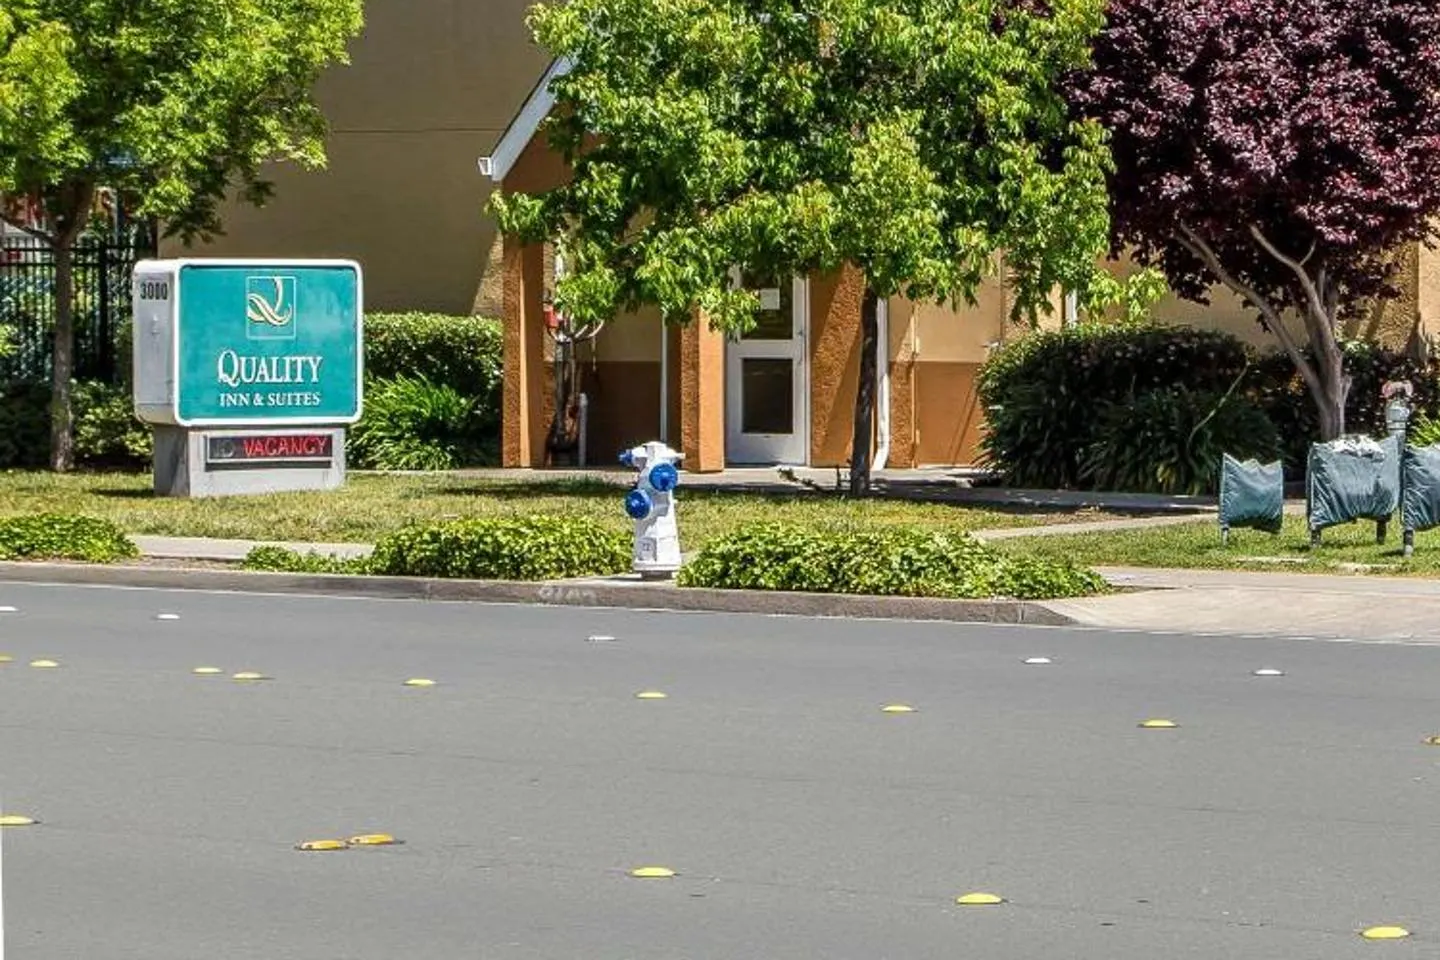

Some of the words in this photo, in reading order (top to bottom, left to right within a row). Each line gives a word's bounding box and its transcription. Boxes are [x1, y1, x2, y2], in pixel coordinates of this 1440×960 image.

[218, 349, 322, 387] QUALITY
[219, 392, 250, 407] INN
[252, 392, 264, 406] &
[267, 392, 321, 406] SUITES
[243, 435, 327, 457] VACANCY
